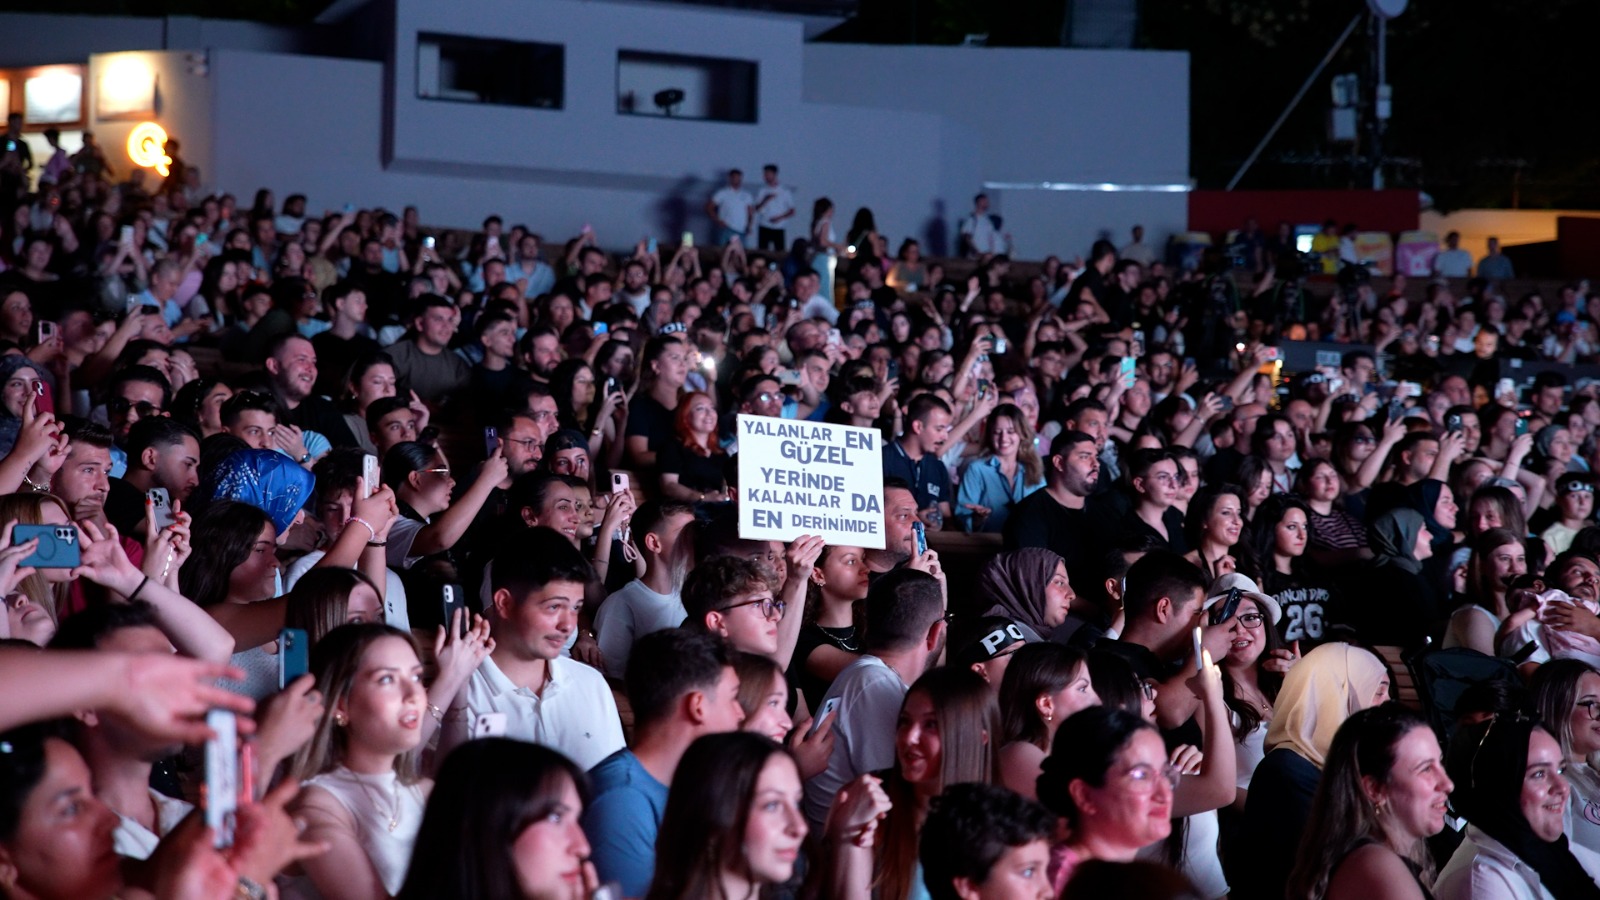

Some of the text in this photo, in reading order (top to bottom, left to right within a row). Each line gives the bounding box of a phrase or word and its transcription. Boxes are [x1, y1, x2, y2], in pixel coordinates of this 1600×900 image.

[744, 420, 873, 451] YALANLAR EN
[780, 440, 854, 466] GÜZEL
[760, 467, 845, 492] YERİNDE
[748, 488, 881, 513] KALANLAR DA
[752, 509, 878, 534] EN DERİNİMDE
[1284, 603, 1324, 642] 26
